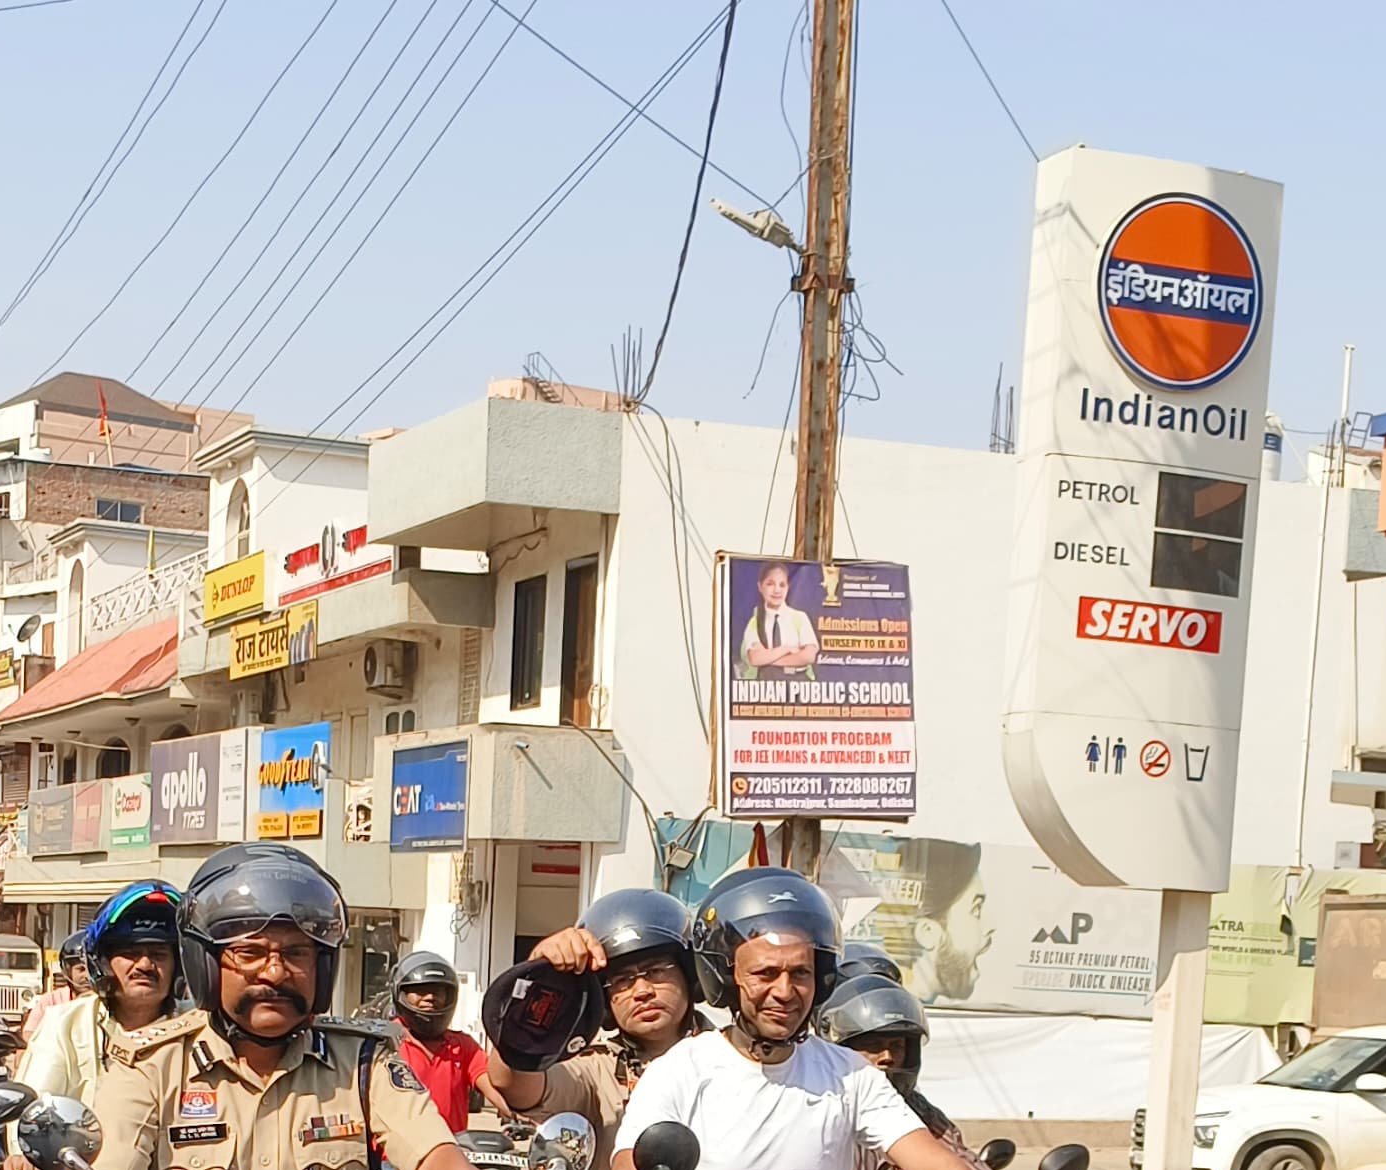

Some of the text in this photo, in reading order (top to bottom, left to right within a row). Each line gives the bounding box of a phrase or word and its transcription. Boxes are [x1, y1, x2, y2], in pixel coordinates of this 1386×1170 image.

[1107, 261, 1254, 315] इंडियनऑयल
[1080, 387, 1247, 441] IndianOil
[1058, 480, 1140, 506] PETROL
[1053, 542, 1131, 567] DIESEL
[221, 574, 256, 602] DUNLOP
[235, 610, 291, 664] राज टायर्स
[1084, 601, 1207, 650] SERVO
[864, 639, 875, 649] TO
[732, 680, 911, 705] INDIAN PUBLIC SCHOOL
[752, 731, 892, 746] FOUNDATION PROGRAM
[734, 749, 753, 764] FOR
[755, 750, 770, 764] JEE
[888, 751, 911, 764] NEET
[258, 750, 312, 792] GOODYEAR
[161, 752, 207, 826] apollo
[829, 777, 912, 795] 7328088267
[394, 784, 422, 816] CEAT
[182, 810, 207, 830] TYRES
[1029, 950, 1150, 970] 95 OCTANE PREMIUM PETROL
